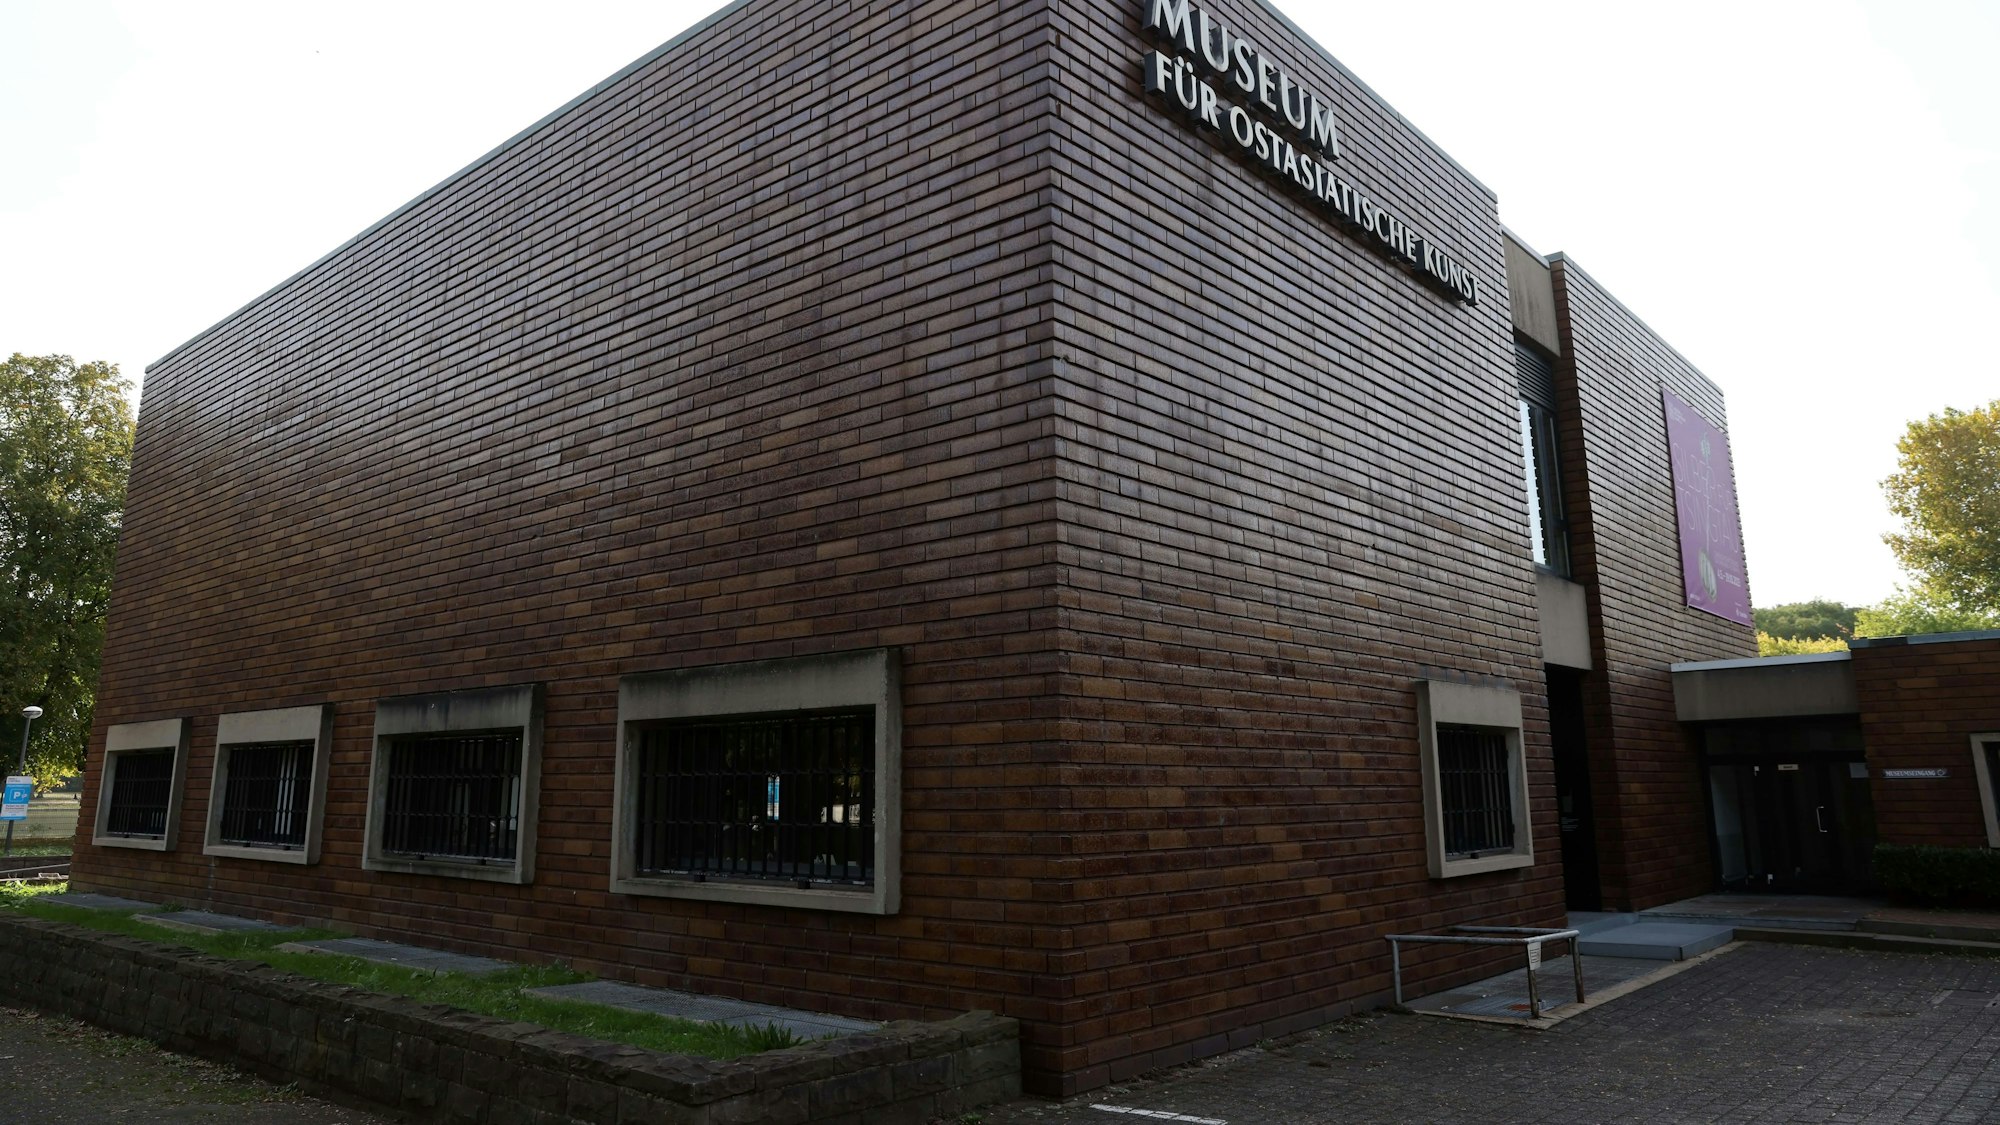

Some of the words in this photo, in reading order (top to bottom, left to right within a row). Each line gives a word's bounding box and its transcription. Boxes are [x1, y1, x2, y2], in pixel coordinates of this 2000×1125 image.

[1153, 0, 1341, 161] MUSEUM
[1155, 50, 1221, 131] FÜR
[1229, 104, 1418, 262] OSTASIATISCHE
[1423, 238, 1482, 307] KUNST
[13, 791, 21, 799] P
[1885, 769, 1936, 777] MUSEUMSEINGANG
